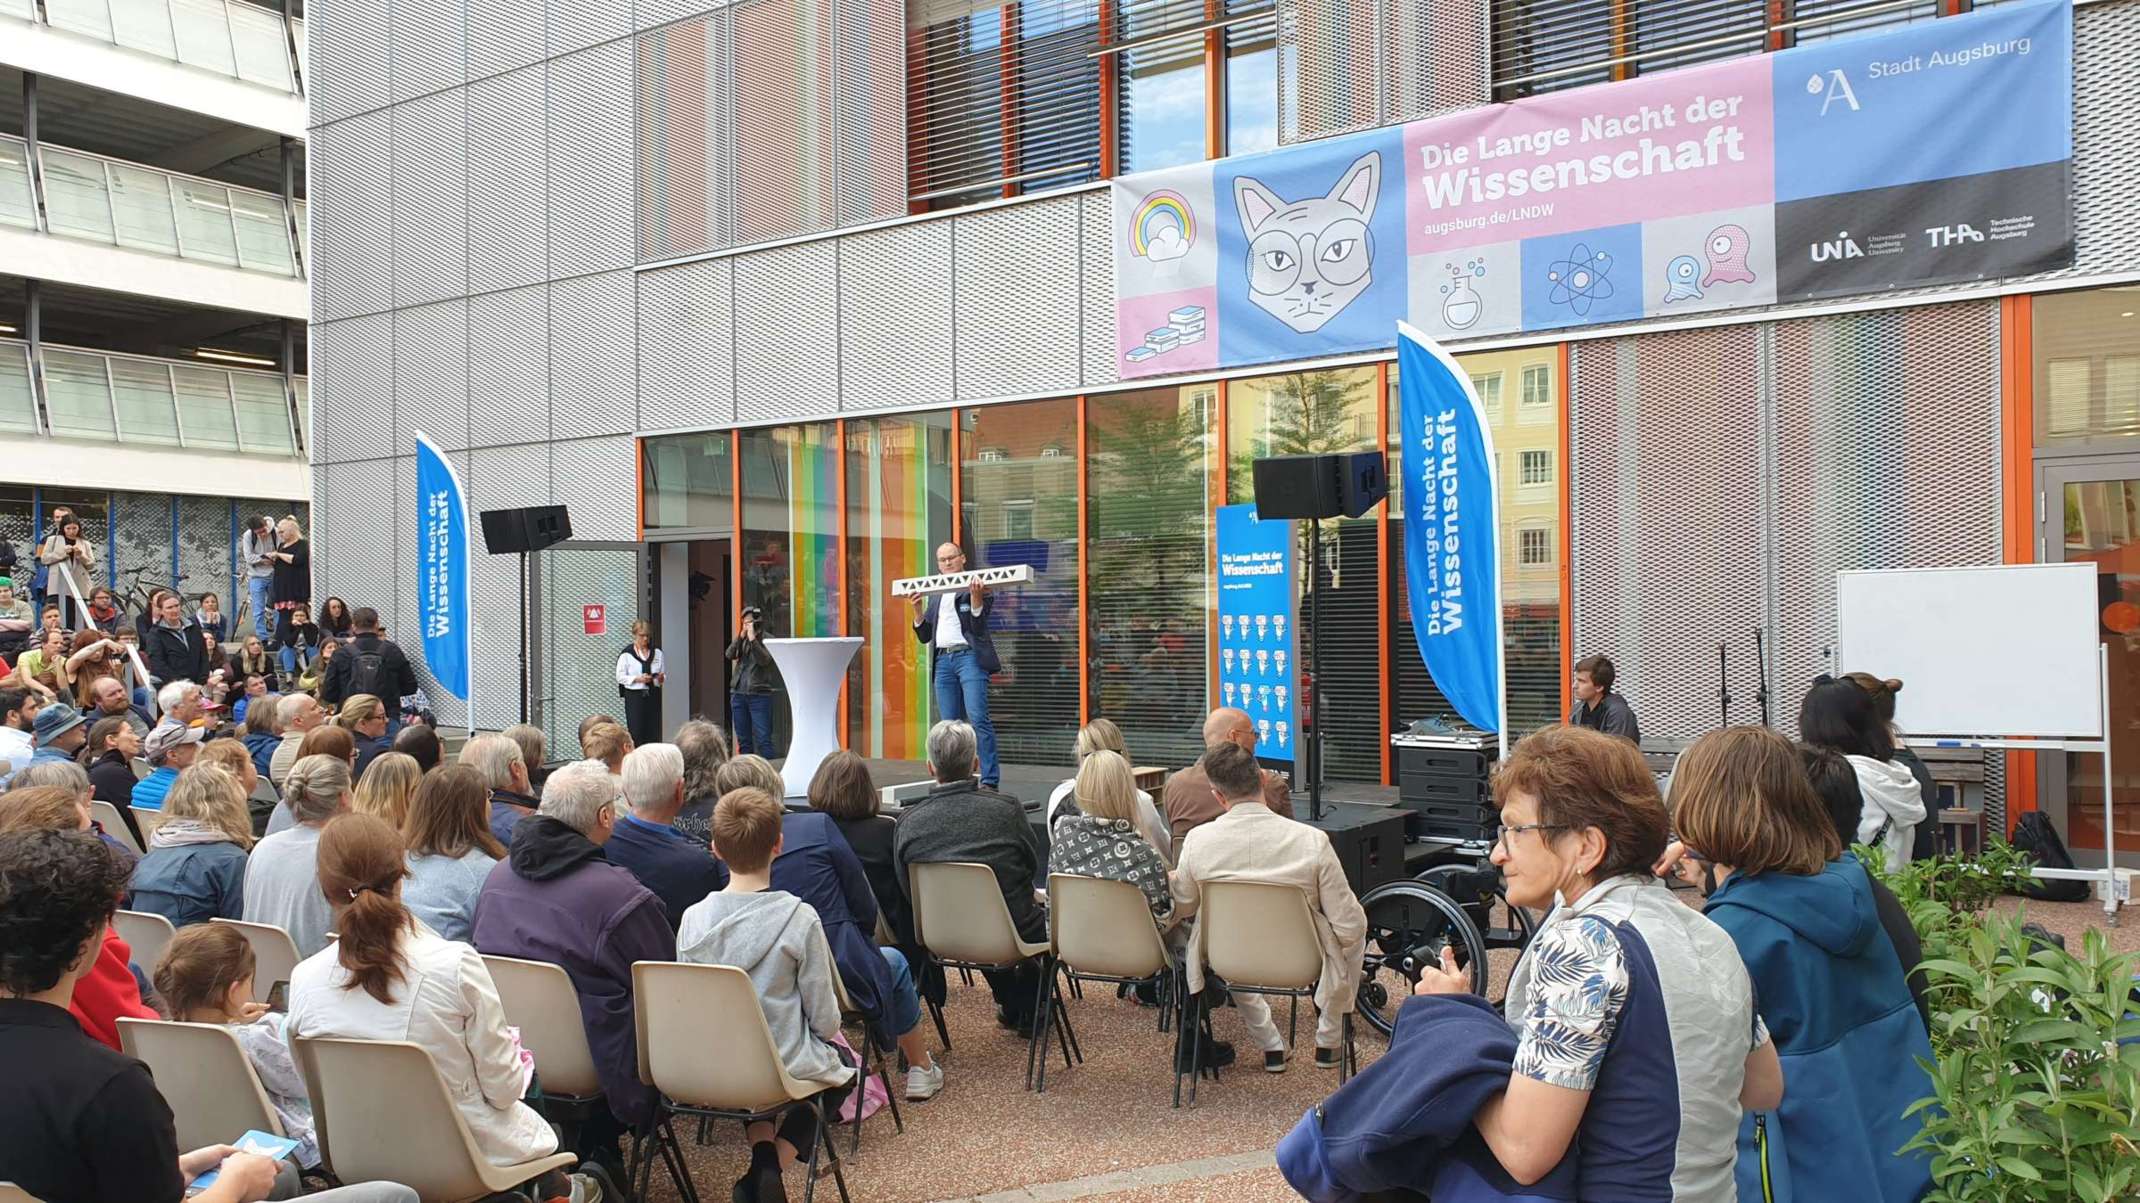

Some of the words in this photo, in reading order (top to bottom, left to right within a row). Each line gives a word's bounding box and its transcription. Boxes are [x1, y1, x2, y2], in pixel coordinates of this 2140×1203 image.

[1868, 56, 1920, 79] Stadt
[1928, 38, 2032, 68] Augsburg
[1421, 144, 1468, 169] Die
[1477, 126, 1570, 160] Lange
[1580, 105, 1675, 143] Nacht
[1685, 95, 1743, 124] der
[1422, 126, 1745, 210] Wissenschaft
[1424, 203, 1555, 236] augsburg.de/LNDW
[1422, 415, 1434, 452] der
[428, 493, 437, 516] der
[1422, 456, 1437, 521] Nacht
[428, 520, 437, 563] Nacht
[1437, 408, 1463, 635] Wissenschaft
[436, 490, 450, 638] Wissenschaft
[1222, 561, 1284, 576] Wissenschaft
[1426, 527, 1439, 594] Lange
[428, 566, 438, 611] Lange
[427, 615, 436, 639] Die
[1428, 600, 1441, 636] Die
